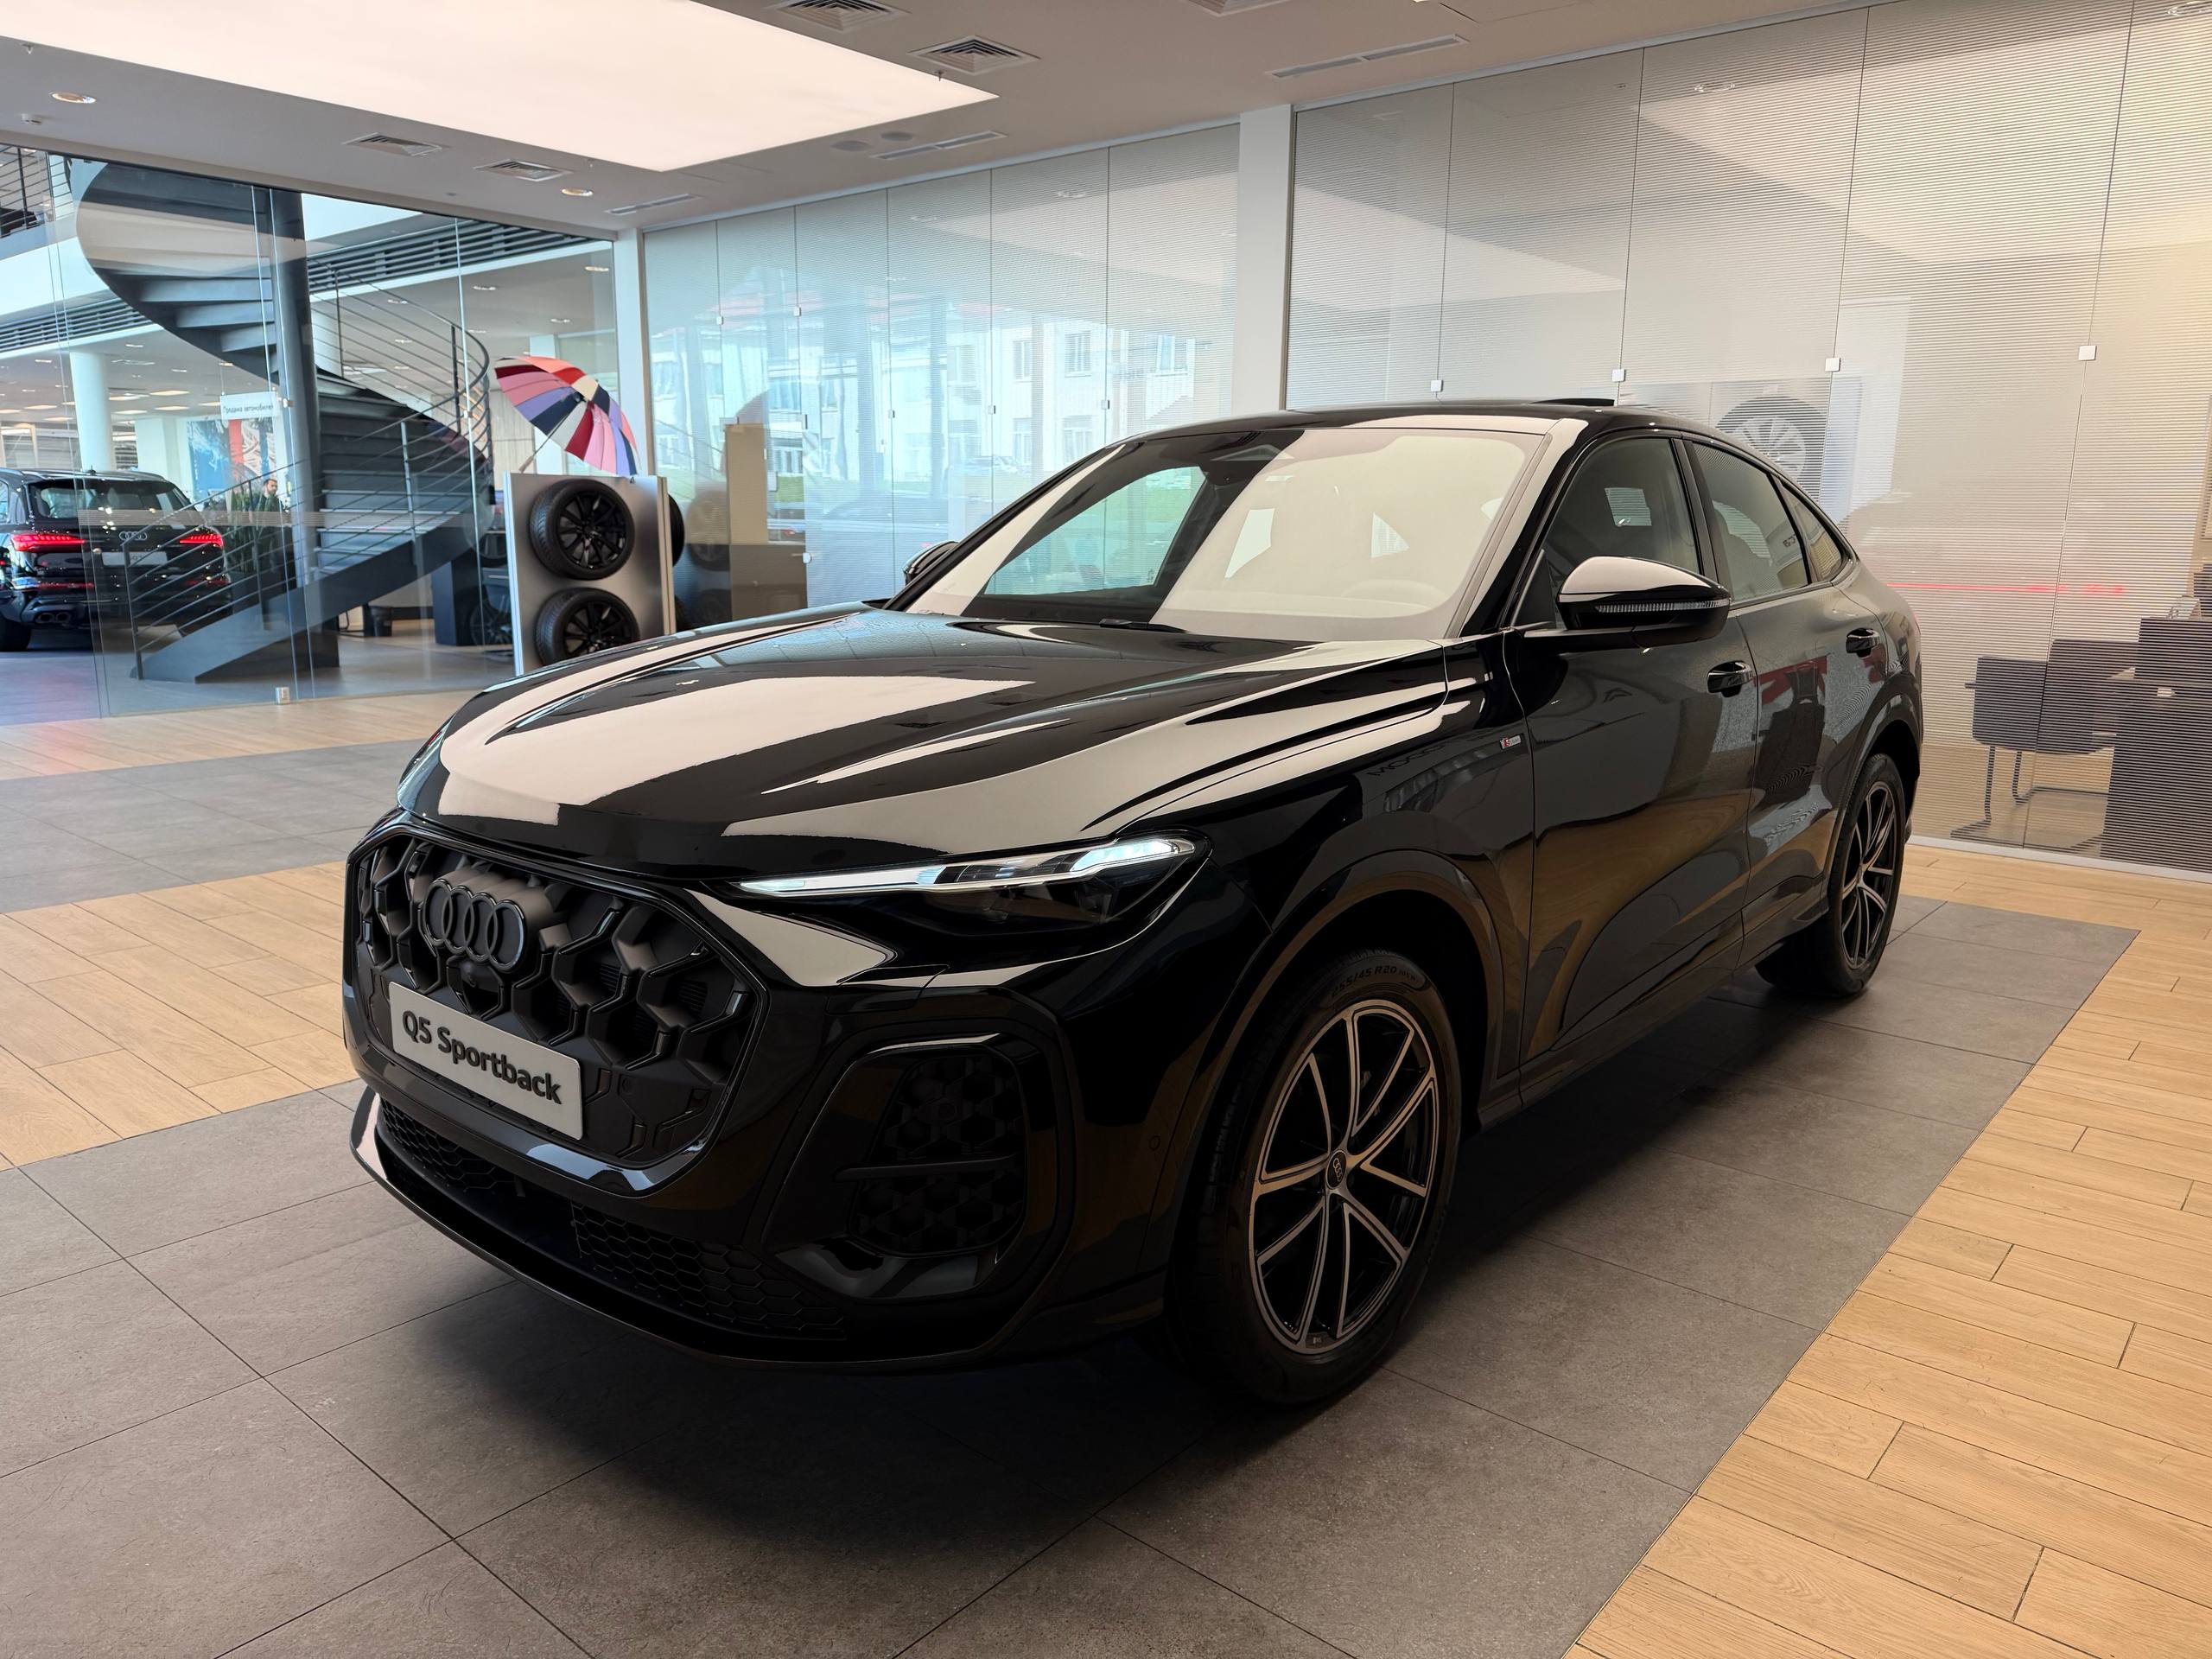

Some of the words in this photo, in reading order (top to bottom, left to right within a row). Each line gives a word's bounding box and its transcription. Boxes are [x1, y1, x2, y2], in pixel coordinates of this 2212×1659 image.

[1375, 964, 1397, 975] R20
[402, 1010, 432, 1044] Q5
[437, 1027, 563, 1105] Sportback
